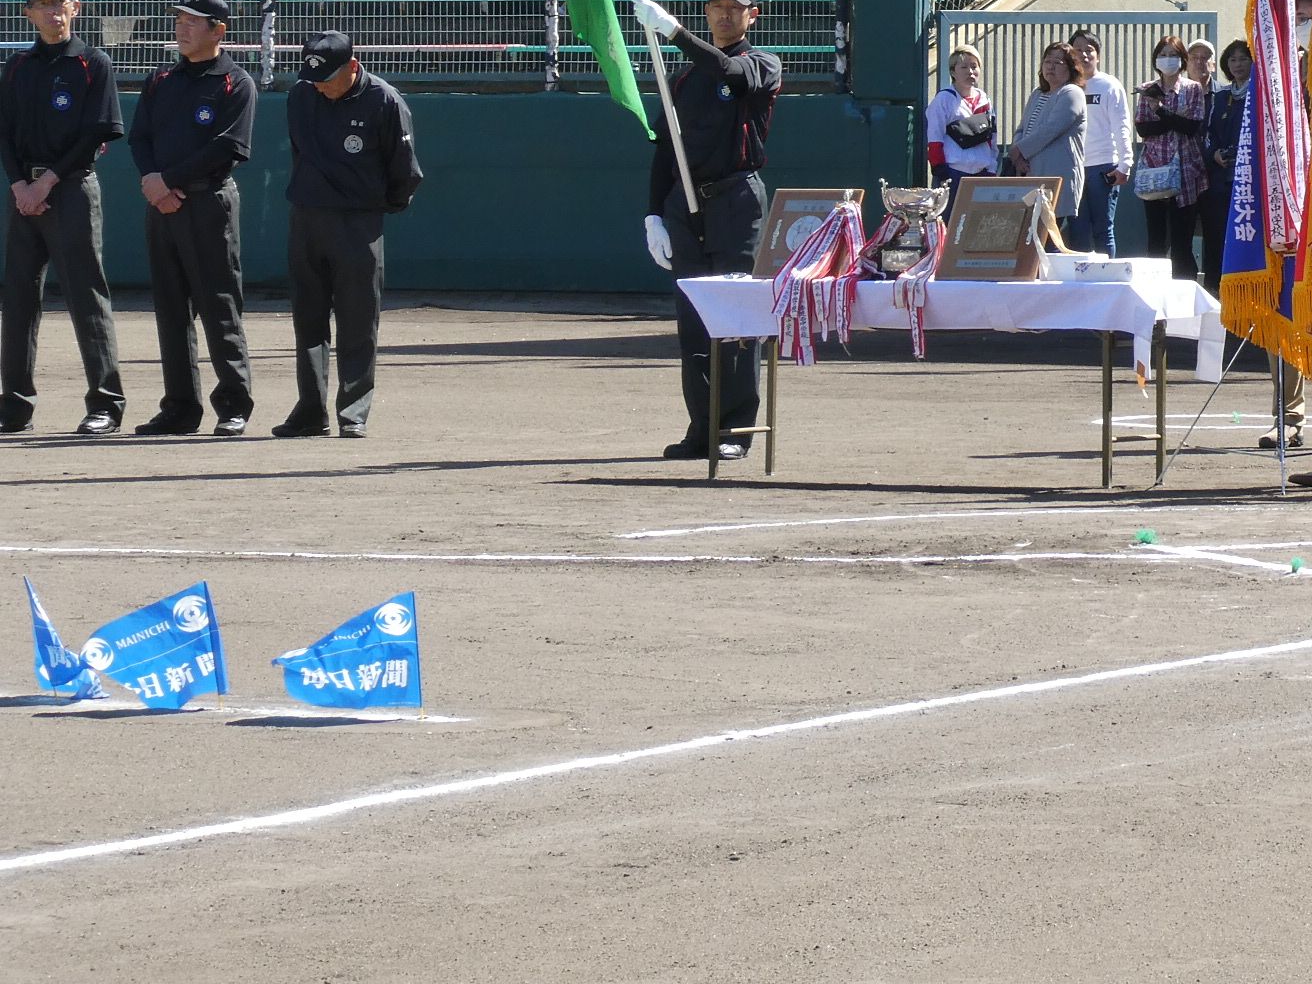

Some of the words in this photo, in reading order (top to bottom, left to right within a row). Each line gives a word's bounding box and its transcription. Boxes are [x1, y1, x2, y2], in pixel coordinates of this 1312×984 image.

[116, 620, 171, 650] MAINICHI
[122, 651, 216, 699] 日新聞
[300, 659, 409, 691] 毎日新聞
